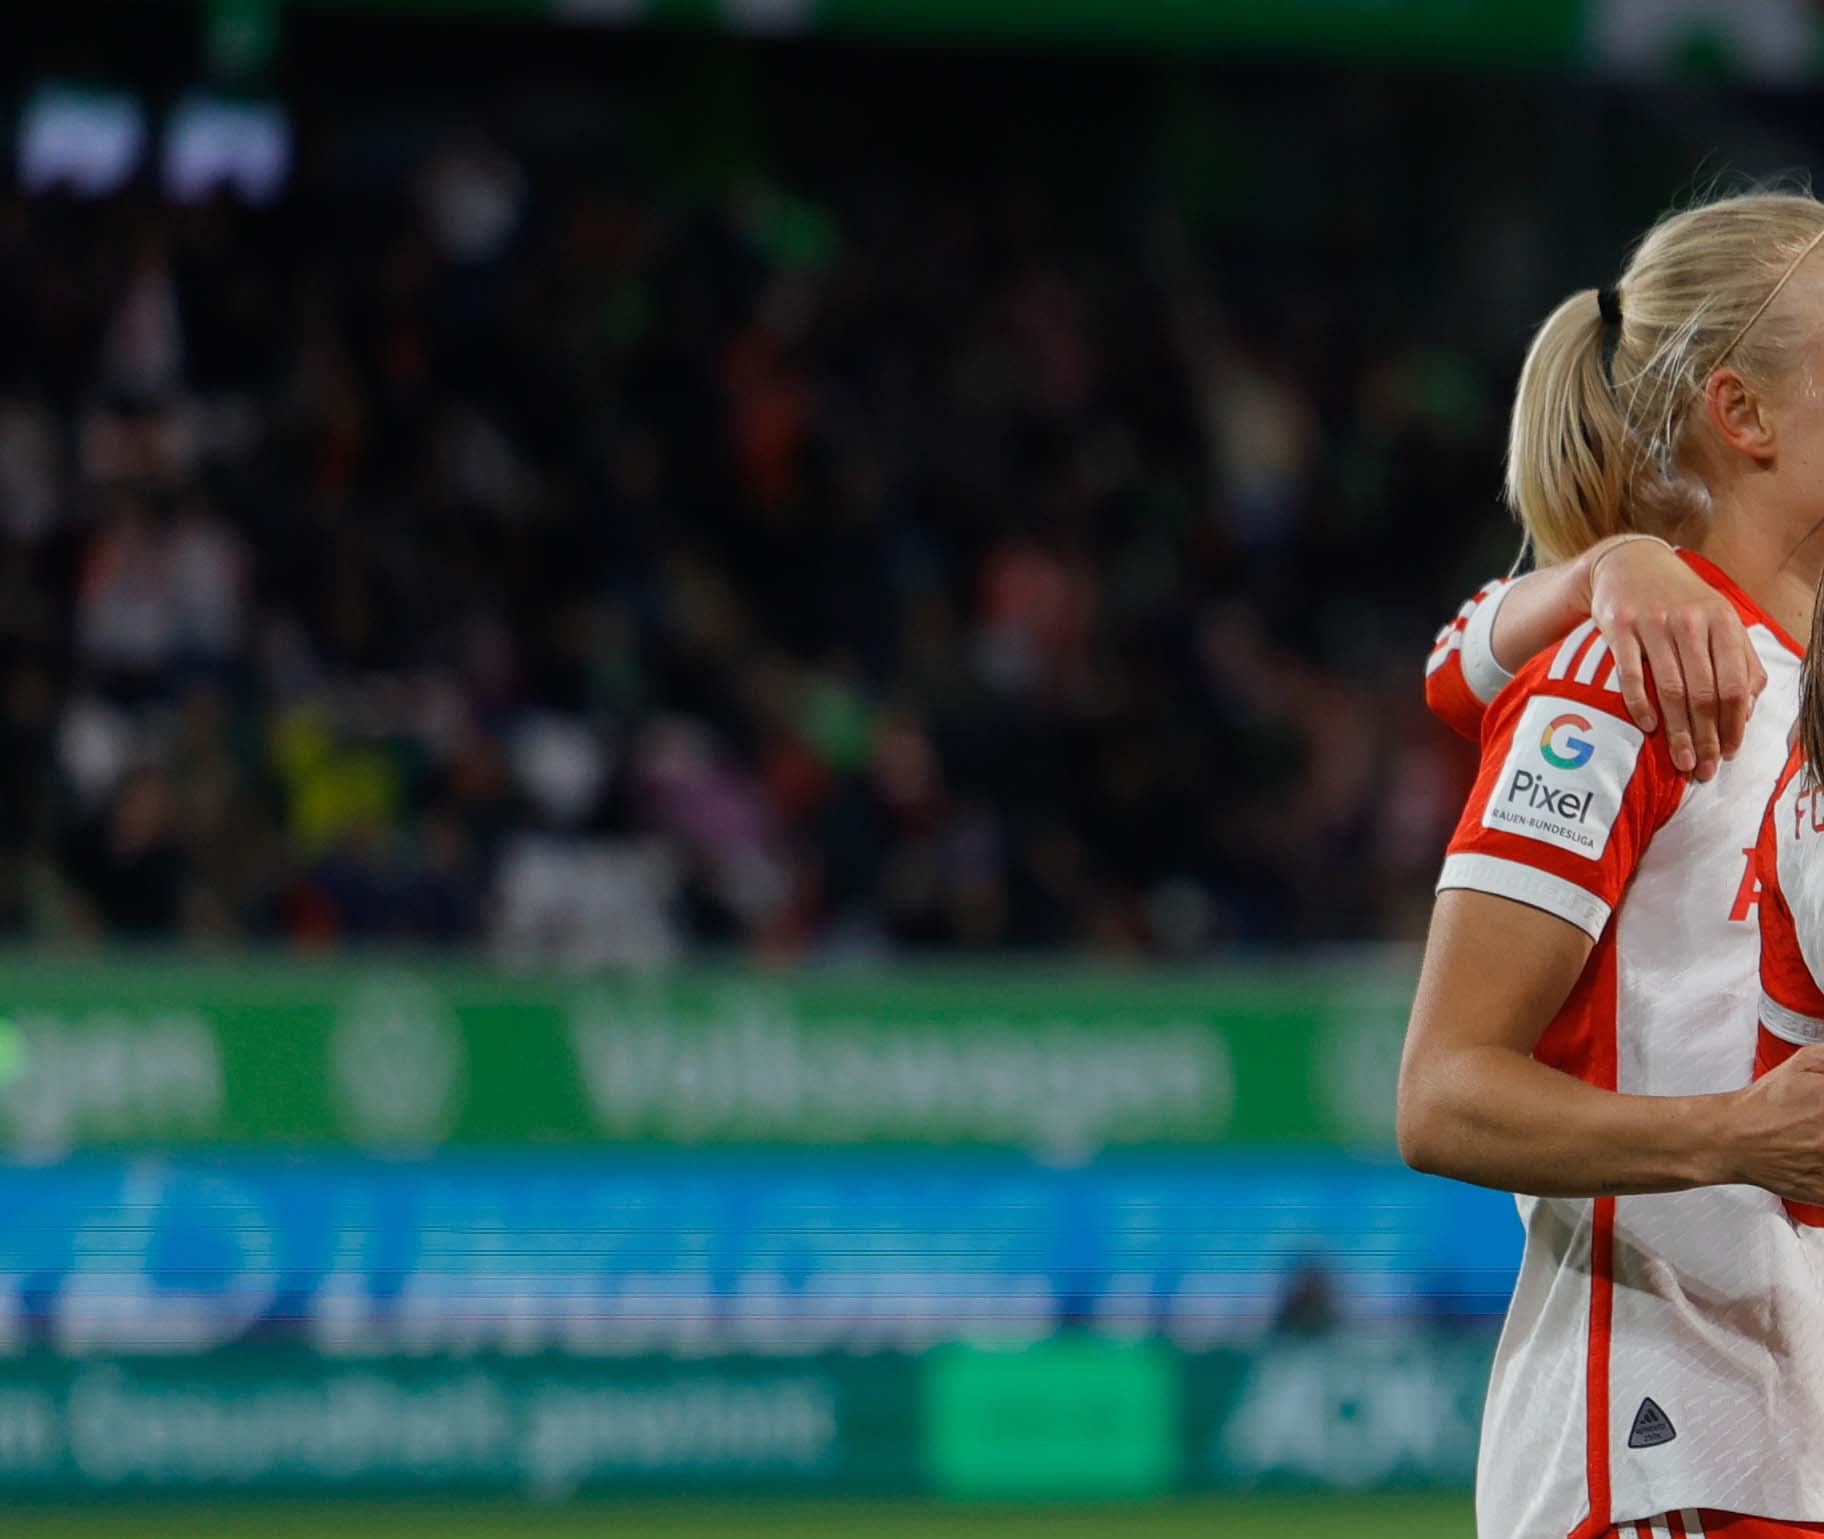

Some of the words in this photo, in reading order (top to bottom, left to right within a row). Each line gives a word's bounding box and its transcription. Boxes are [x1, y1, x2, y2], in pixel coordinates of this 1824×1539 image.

[1539, 712, 1595, 770] G
[1507, 769, 1593, 824] Pixel
[1492, 809, 1594, 849] RAUEN-BUNDESLIGA
